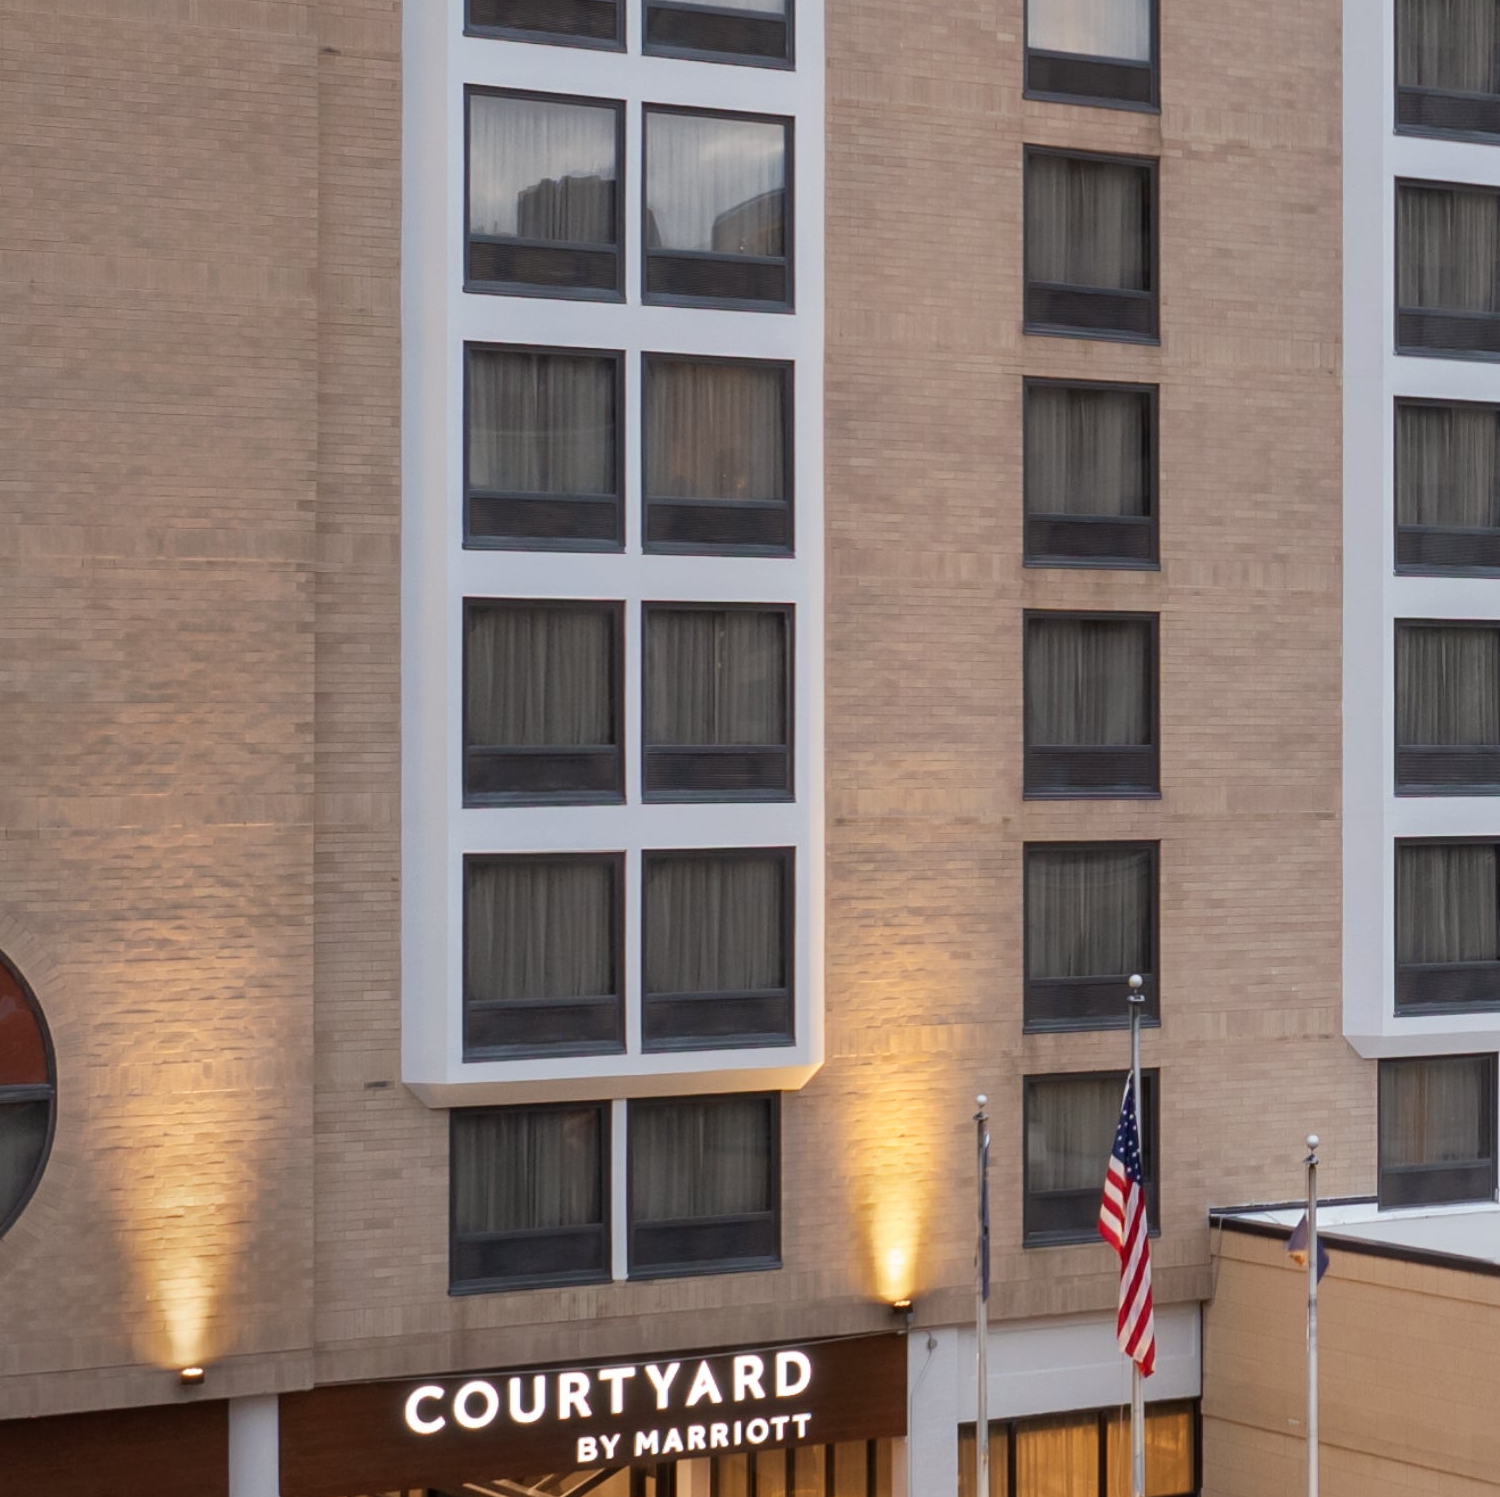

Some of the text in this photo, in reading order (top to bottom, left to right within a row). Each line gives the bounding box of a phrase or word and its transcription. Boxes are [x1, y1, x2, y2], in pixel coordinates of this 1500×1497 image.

[404, 1350, 812, 1435] COURTYARD
[577, 1412, 812, 1463] BY MARRIOTT
